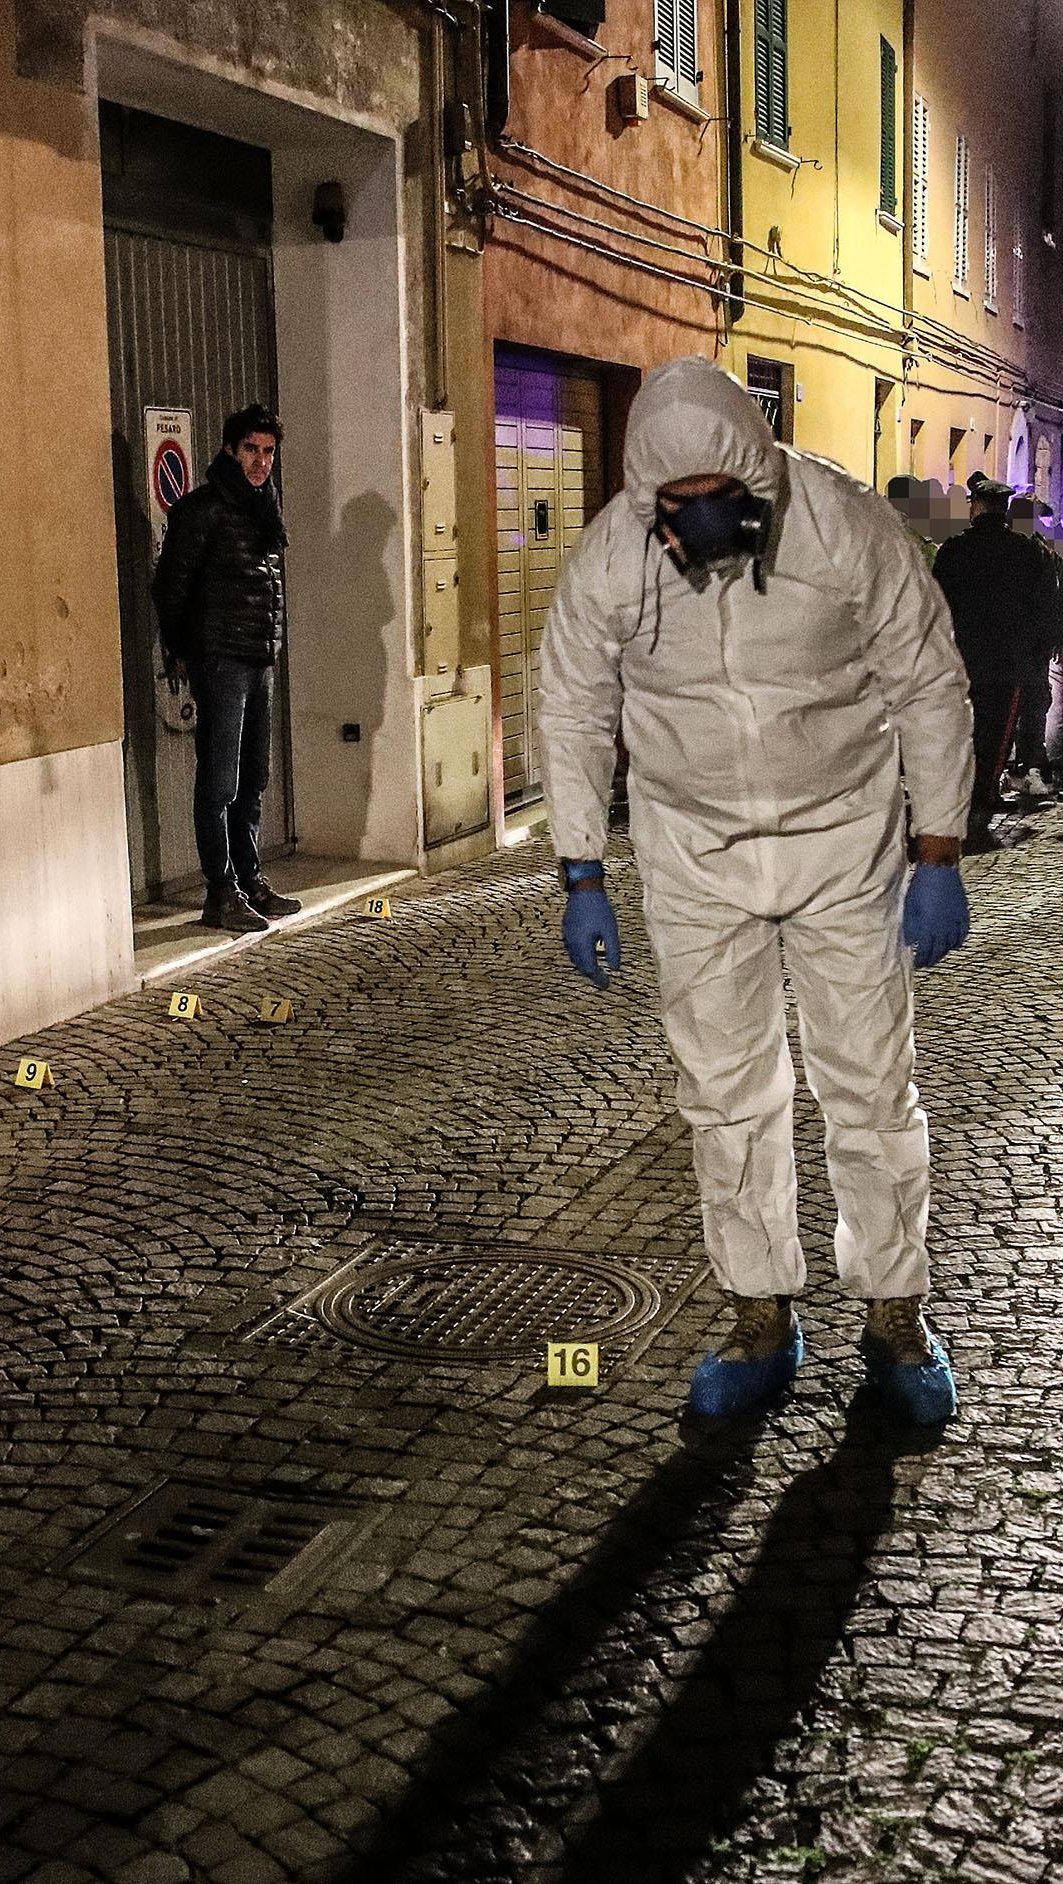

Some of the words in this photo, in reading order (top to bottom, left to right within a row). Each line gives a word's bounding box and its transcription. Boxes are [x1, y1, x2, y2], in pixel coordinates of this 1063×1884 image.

[368, 899, 383, 912] 18
[178, 996, 188, 1011] 8
[270, 1001, 281, 1016] 7
[25, 1063, 37, 1081] 9
[554, 1348, 590, 1376] 16
